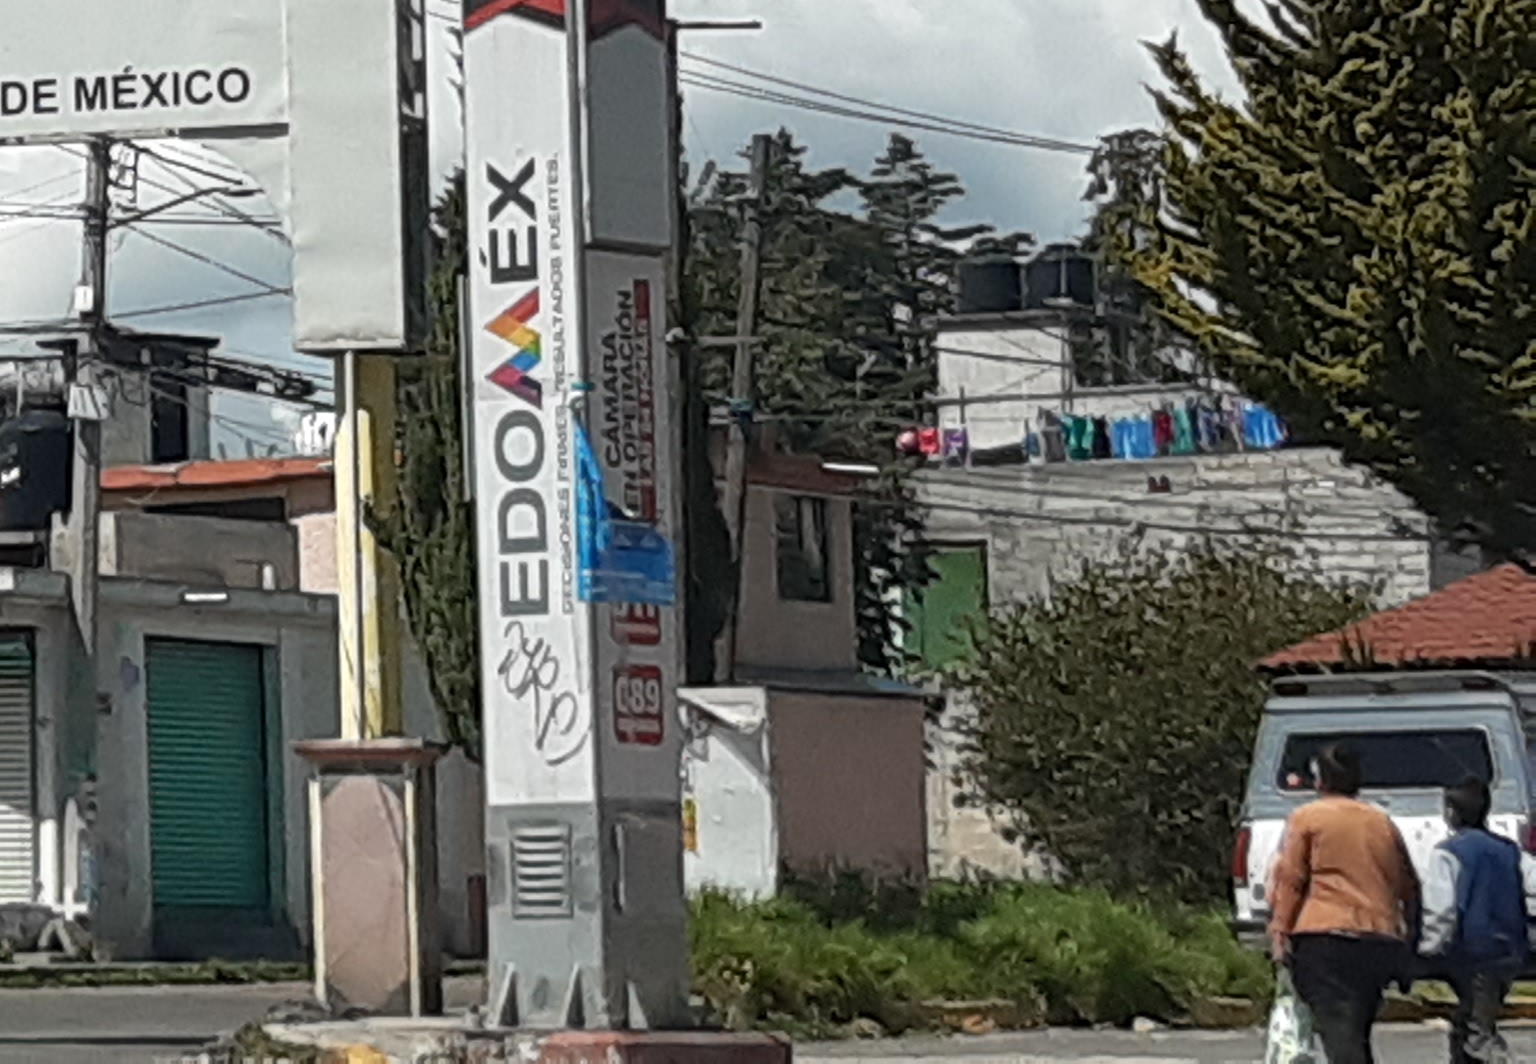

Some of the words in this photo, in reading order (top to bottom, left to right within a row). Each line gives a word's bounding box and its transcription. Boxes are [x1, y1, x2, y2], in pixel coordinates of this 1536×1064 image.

[74, 65, 250, 111] MÉXICO
[479, 157, 549, 617] EDOMÉX
[601, 332, 621, 467] CÁMARA
